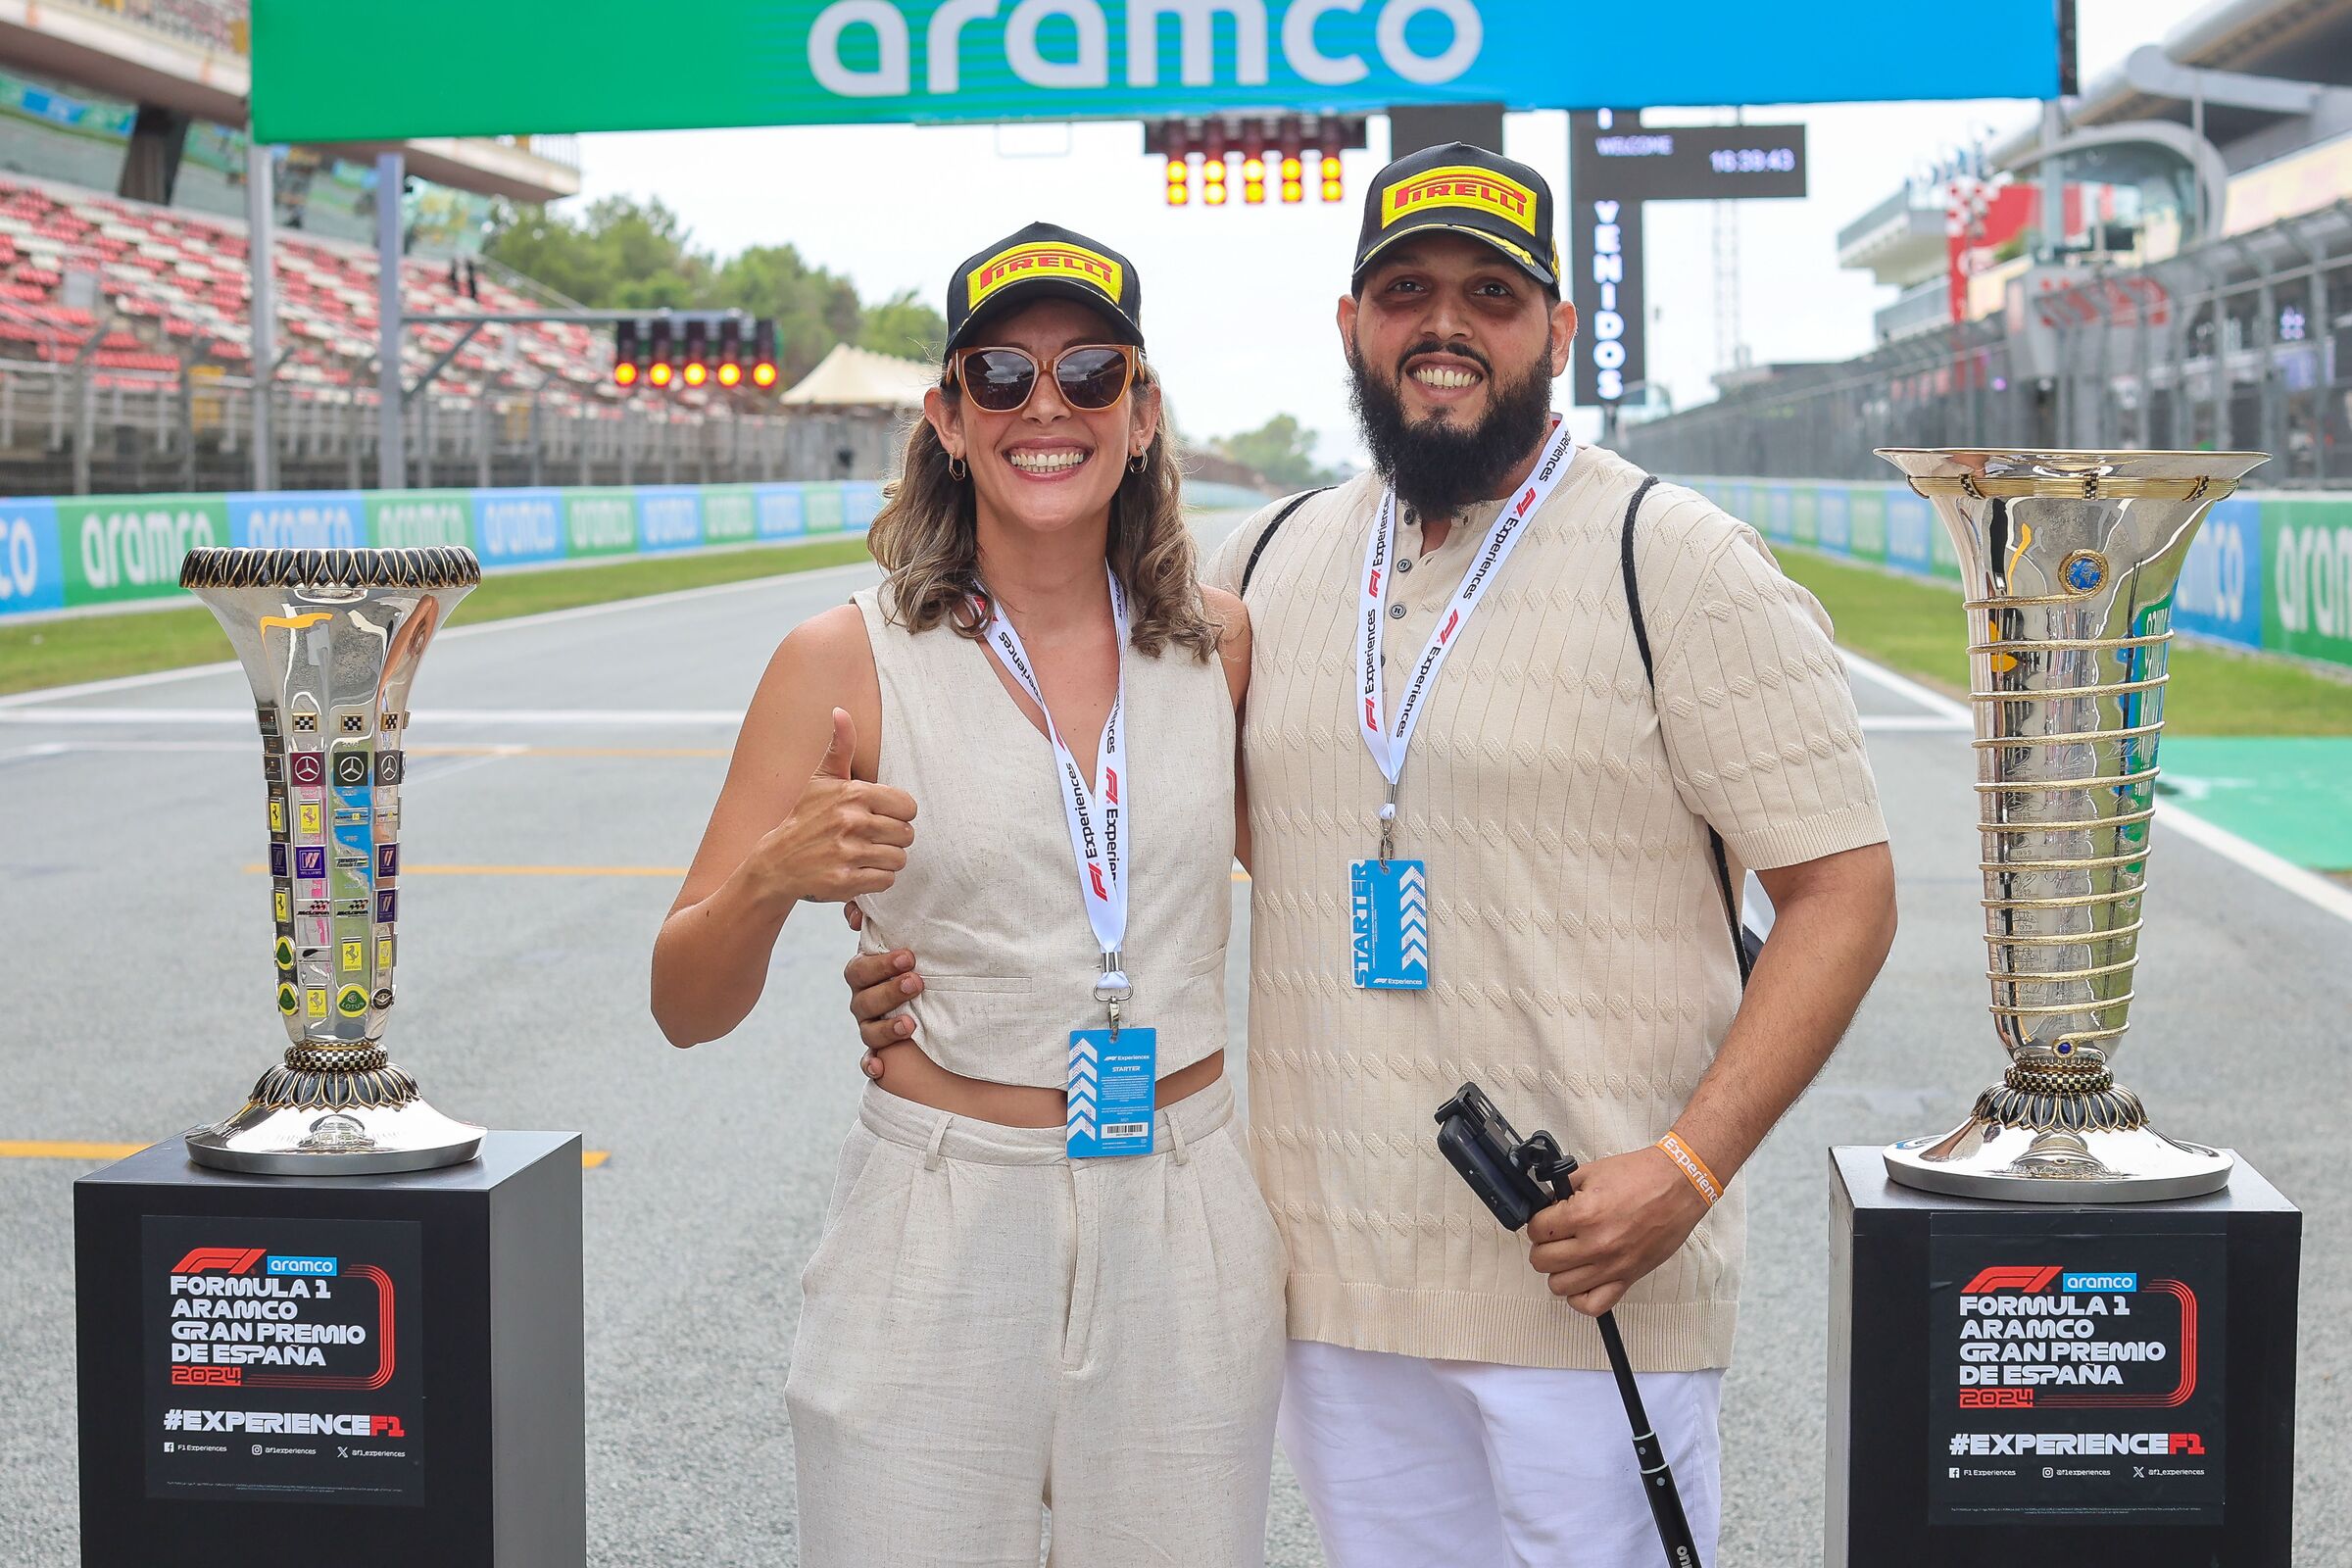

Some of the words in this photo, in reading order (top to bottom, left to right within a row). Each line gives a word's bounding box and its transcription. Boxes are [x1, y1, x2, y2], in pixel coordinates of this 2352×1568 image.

[808, 0, 1484, 96] aramco
[1395, 174, 1527, 217] PIRELLI
[980, 249, 1113, 290] PIRELLI
[1463, 517, 1519, 600] Experiences
[2276, 524, 2352, 642] aram
[1365, 609, 1376, 694] Experiences
[1396, 647, 1441, 738] Experiences
[1065, 762, 1098, 858] Experiences
[1664, 1138, 1719, 1204] Experienc
[270, 1260, 333, 1274] aramco
[171, 1276, 311, 1298] FORMULA
[315, 1279, 331, 1299] 1
[2067, 1276, 2133, 1290] aramco
[171, 1298, 298, 1320] ARAMCO
[1960, 1296, 2107, 1316] FORMULA
[2114, 1296, 2131, 1316] 1
[172, 1321, 253, 1343] GRAN
[257, 1323, 367, 1345] PREMIO
[1960, 1319, 2094, 1340] ARAMCO
[172, 1344, 209, 1363] DE
[213, 1344, 326, 1366] ESPAÑA
[1960, 1342, 2047, 1362] GRAN
[2051, 1342, 2166, 1362] PREMIO
[172, 1365, 242, 1387] 2024
[1960, 1365, 1998, 1385] DE
[2003, 1362, 2124, 1385] ESPAÑA
[1960, 1389, 2034, 1408] 2024
[164, 1409, 406, 1438] #EXPERIENCEF1
[186, 1445, 227, 1453] Experiences
[1949, 1433, 2205, 1456] #EXPERIENCEF1
